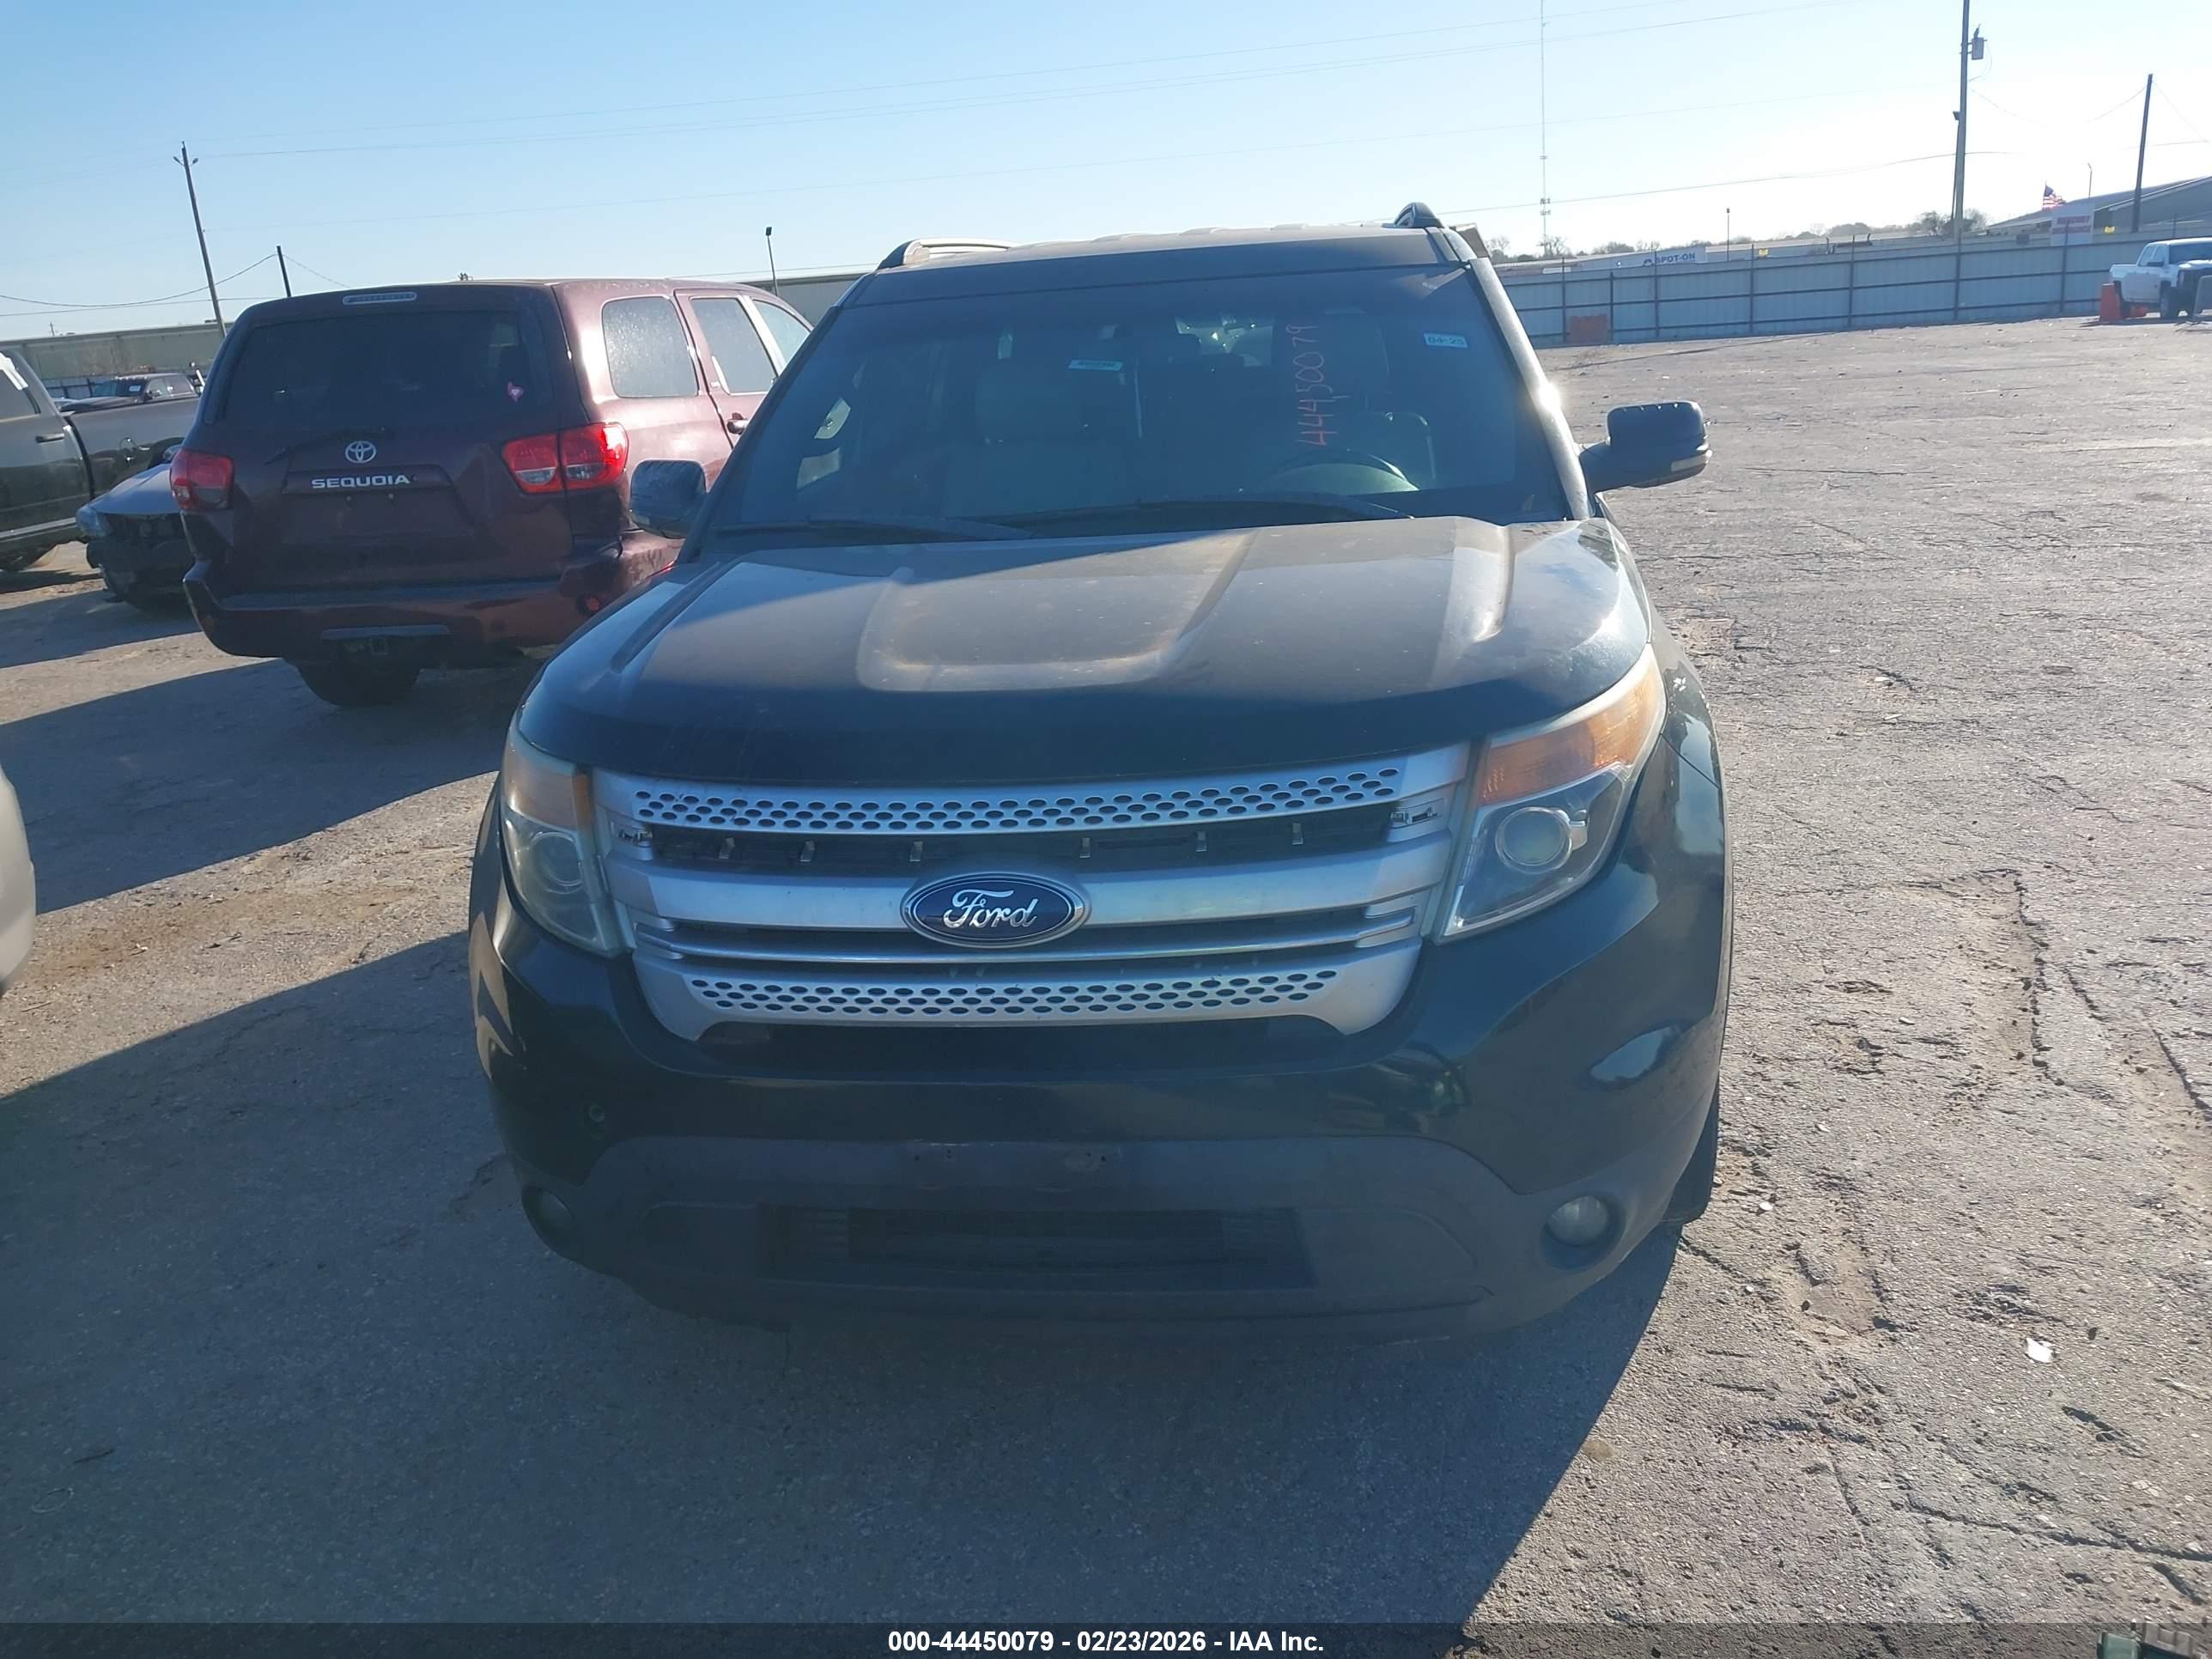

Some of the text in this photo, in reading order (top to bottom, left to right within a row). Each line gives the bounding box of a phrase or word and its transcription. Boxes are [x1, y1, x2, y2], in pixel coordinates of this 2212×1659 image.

[1285, 324, 1337, 447] 44450079
[311, 475, 410, 489] SEQUOIA
[944, 889, 1038, 928] Ford
